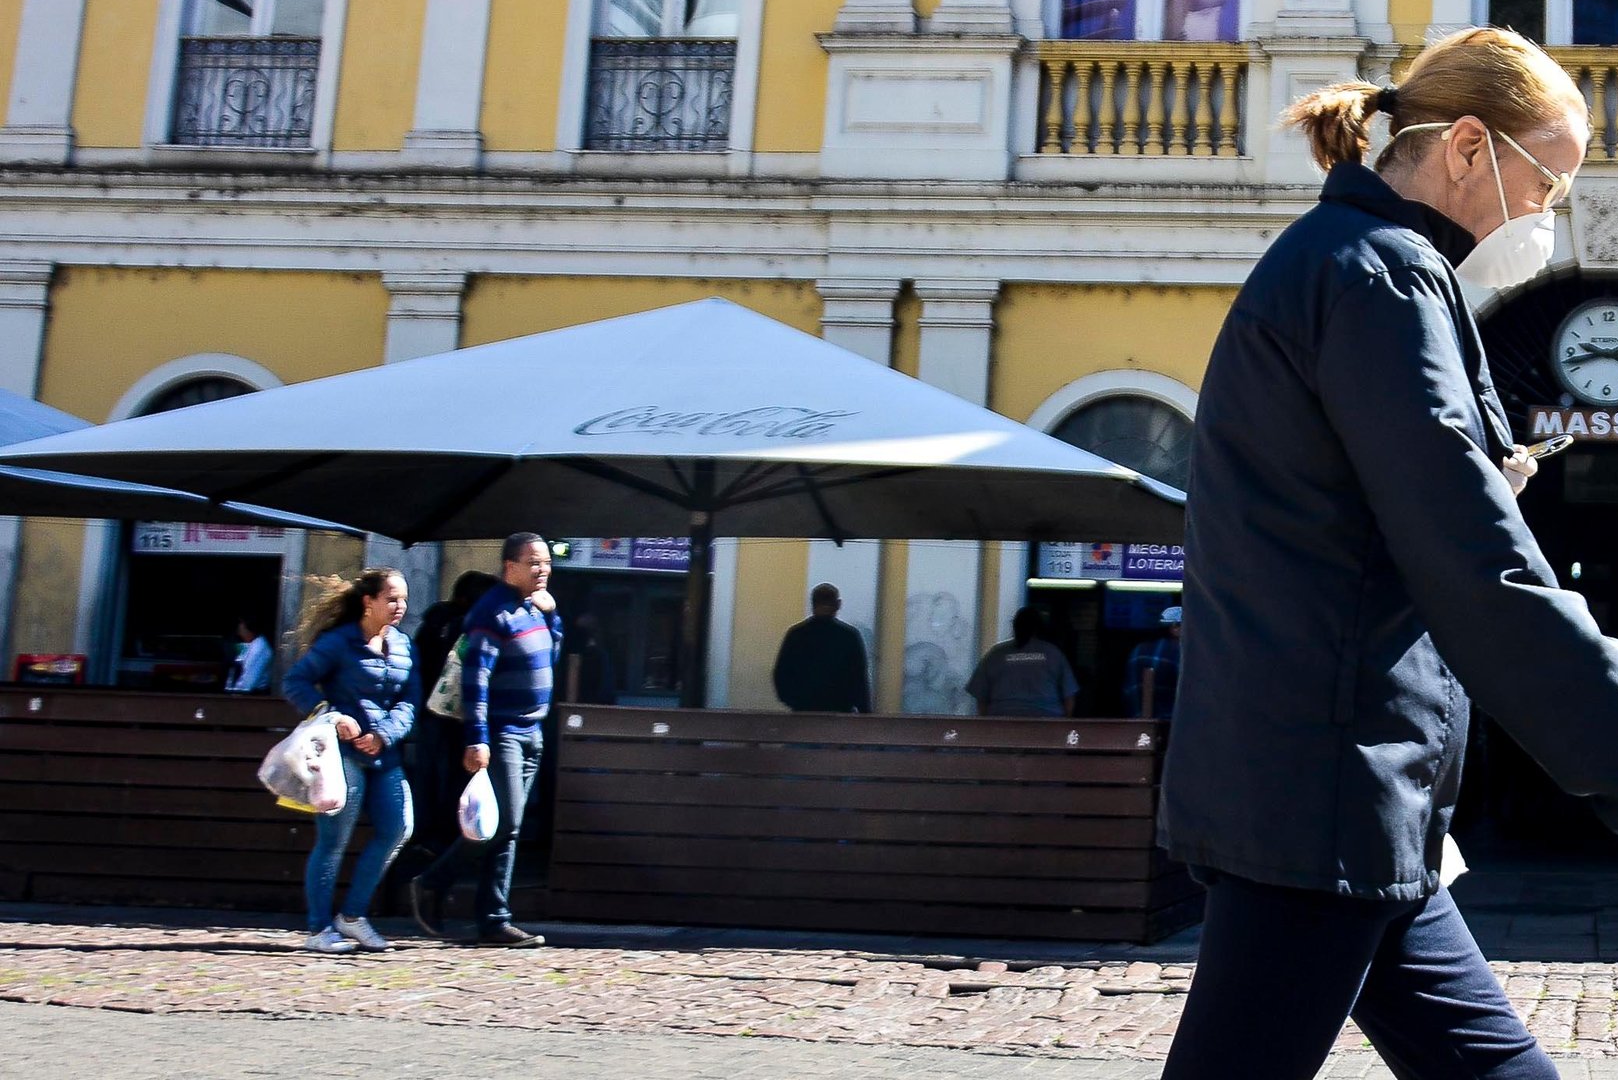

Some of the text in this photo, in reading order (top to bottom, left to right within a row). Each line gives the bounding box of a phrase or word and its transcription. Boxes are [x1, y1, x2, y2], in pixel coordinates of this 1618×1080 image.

[1602, 311, 1615, 322] 12
[1566, 346, 1575, 357] 9
[1602, 384, 1611, 396] 6
[139, 534, 173, 549] 115
[1128, 544, 1168, 555] MEGA
[1048, 561, 1073, 574] 119
